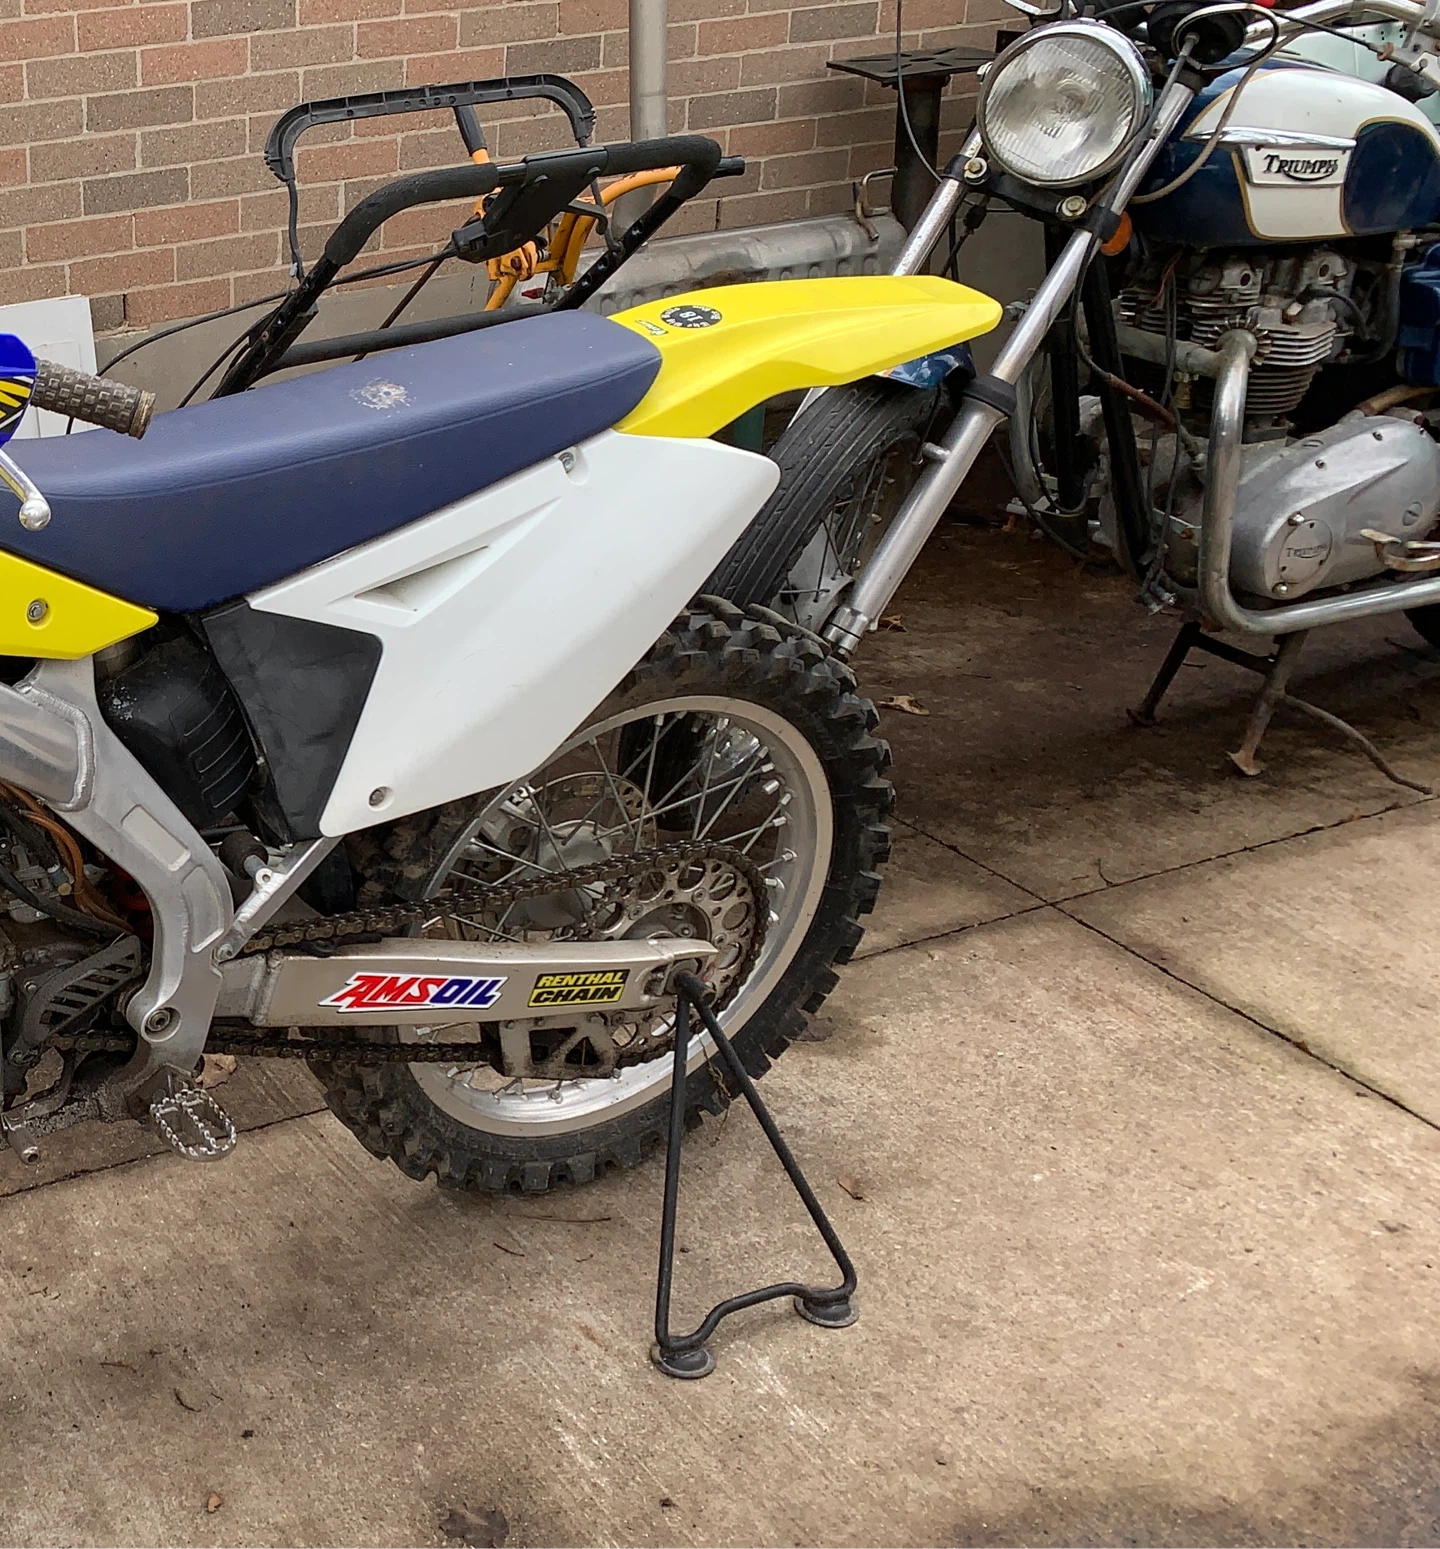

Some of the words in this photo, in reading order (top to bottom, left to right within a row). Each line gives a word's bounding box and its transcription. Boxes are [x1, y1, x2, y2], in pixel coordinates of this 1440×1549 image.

[1263, 154, 1339, 181] TRIUMPH
[537, 971, 625, 988] RENTHAL
[329, 974, 502, 1009] AMSOIL
[531, 987, 621, 1004] CHAIN
